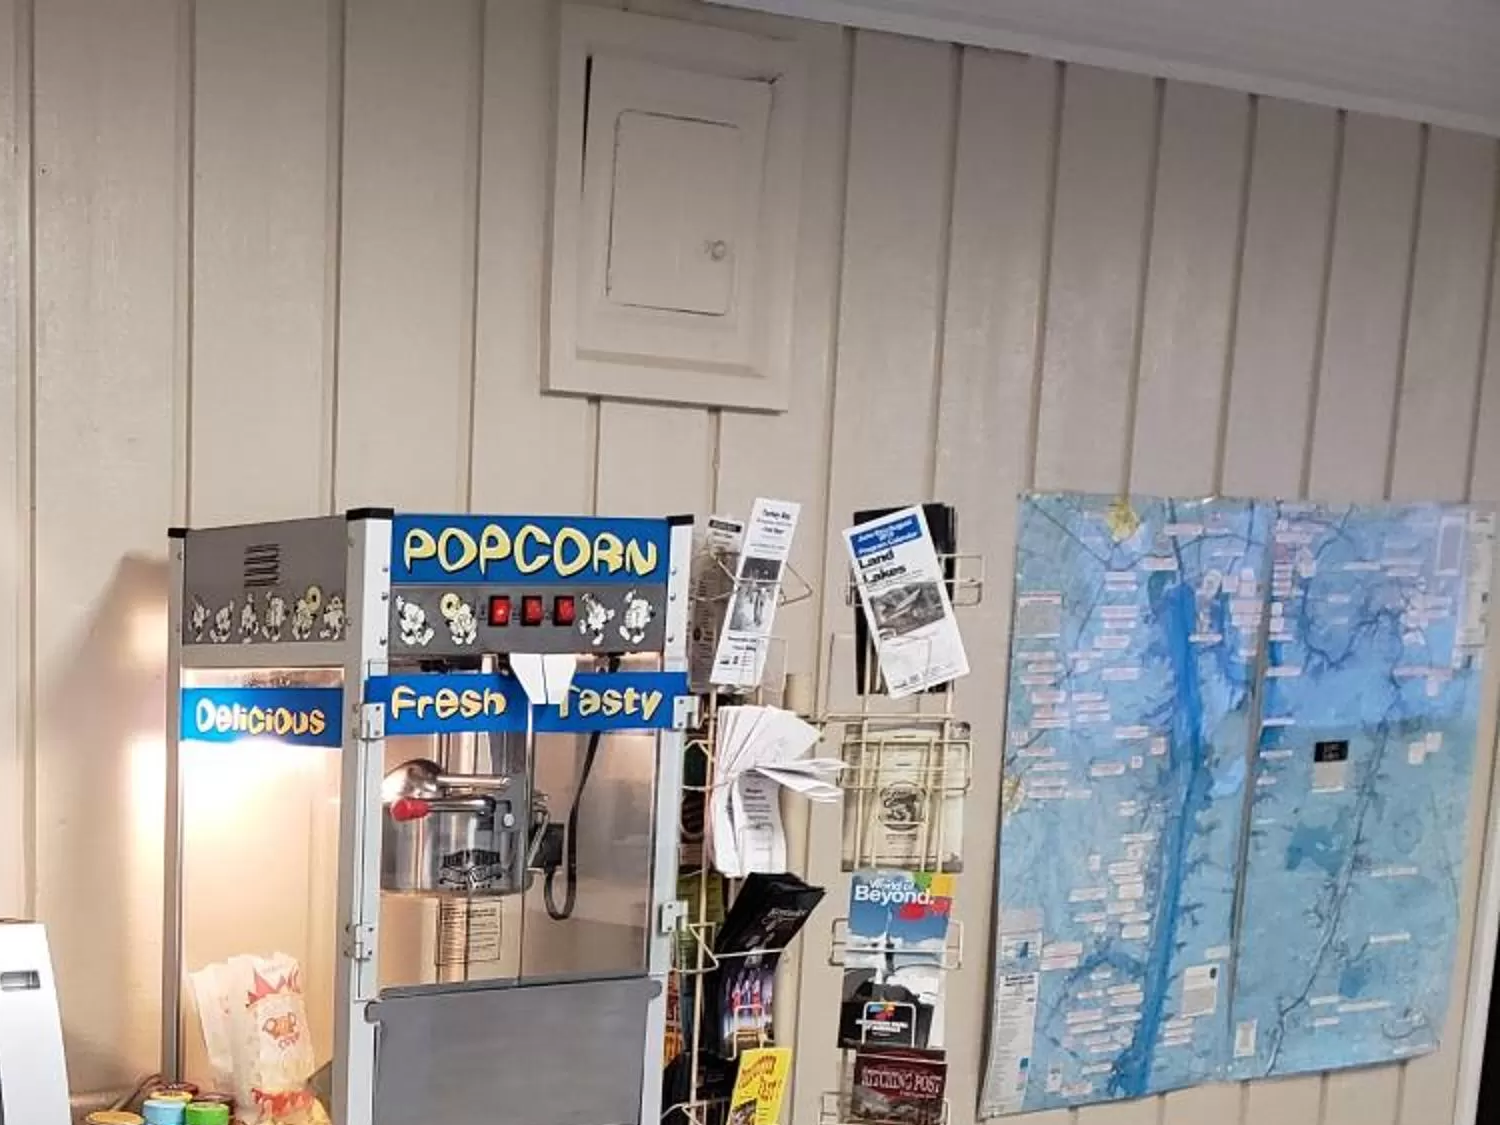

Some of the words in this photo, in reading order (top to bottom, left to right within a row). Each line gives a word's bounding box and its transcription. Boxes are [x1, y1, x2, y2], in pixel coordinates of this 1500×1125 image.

[404, 523, 658, 577] POPCORN
[857, 549, 895, 569] Land
[863, 565, 907, 583] Lakes
[391, 685, 508, 720] Fresh
[195, 697, 326, 735] Delicious
[854, 884, 935, 906] Beyond.
[913, 1073, 943, 1094] POST
